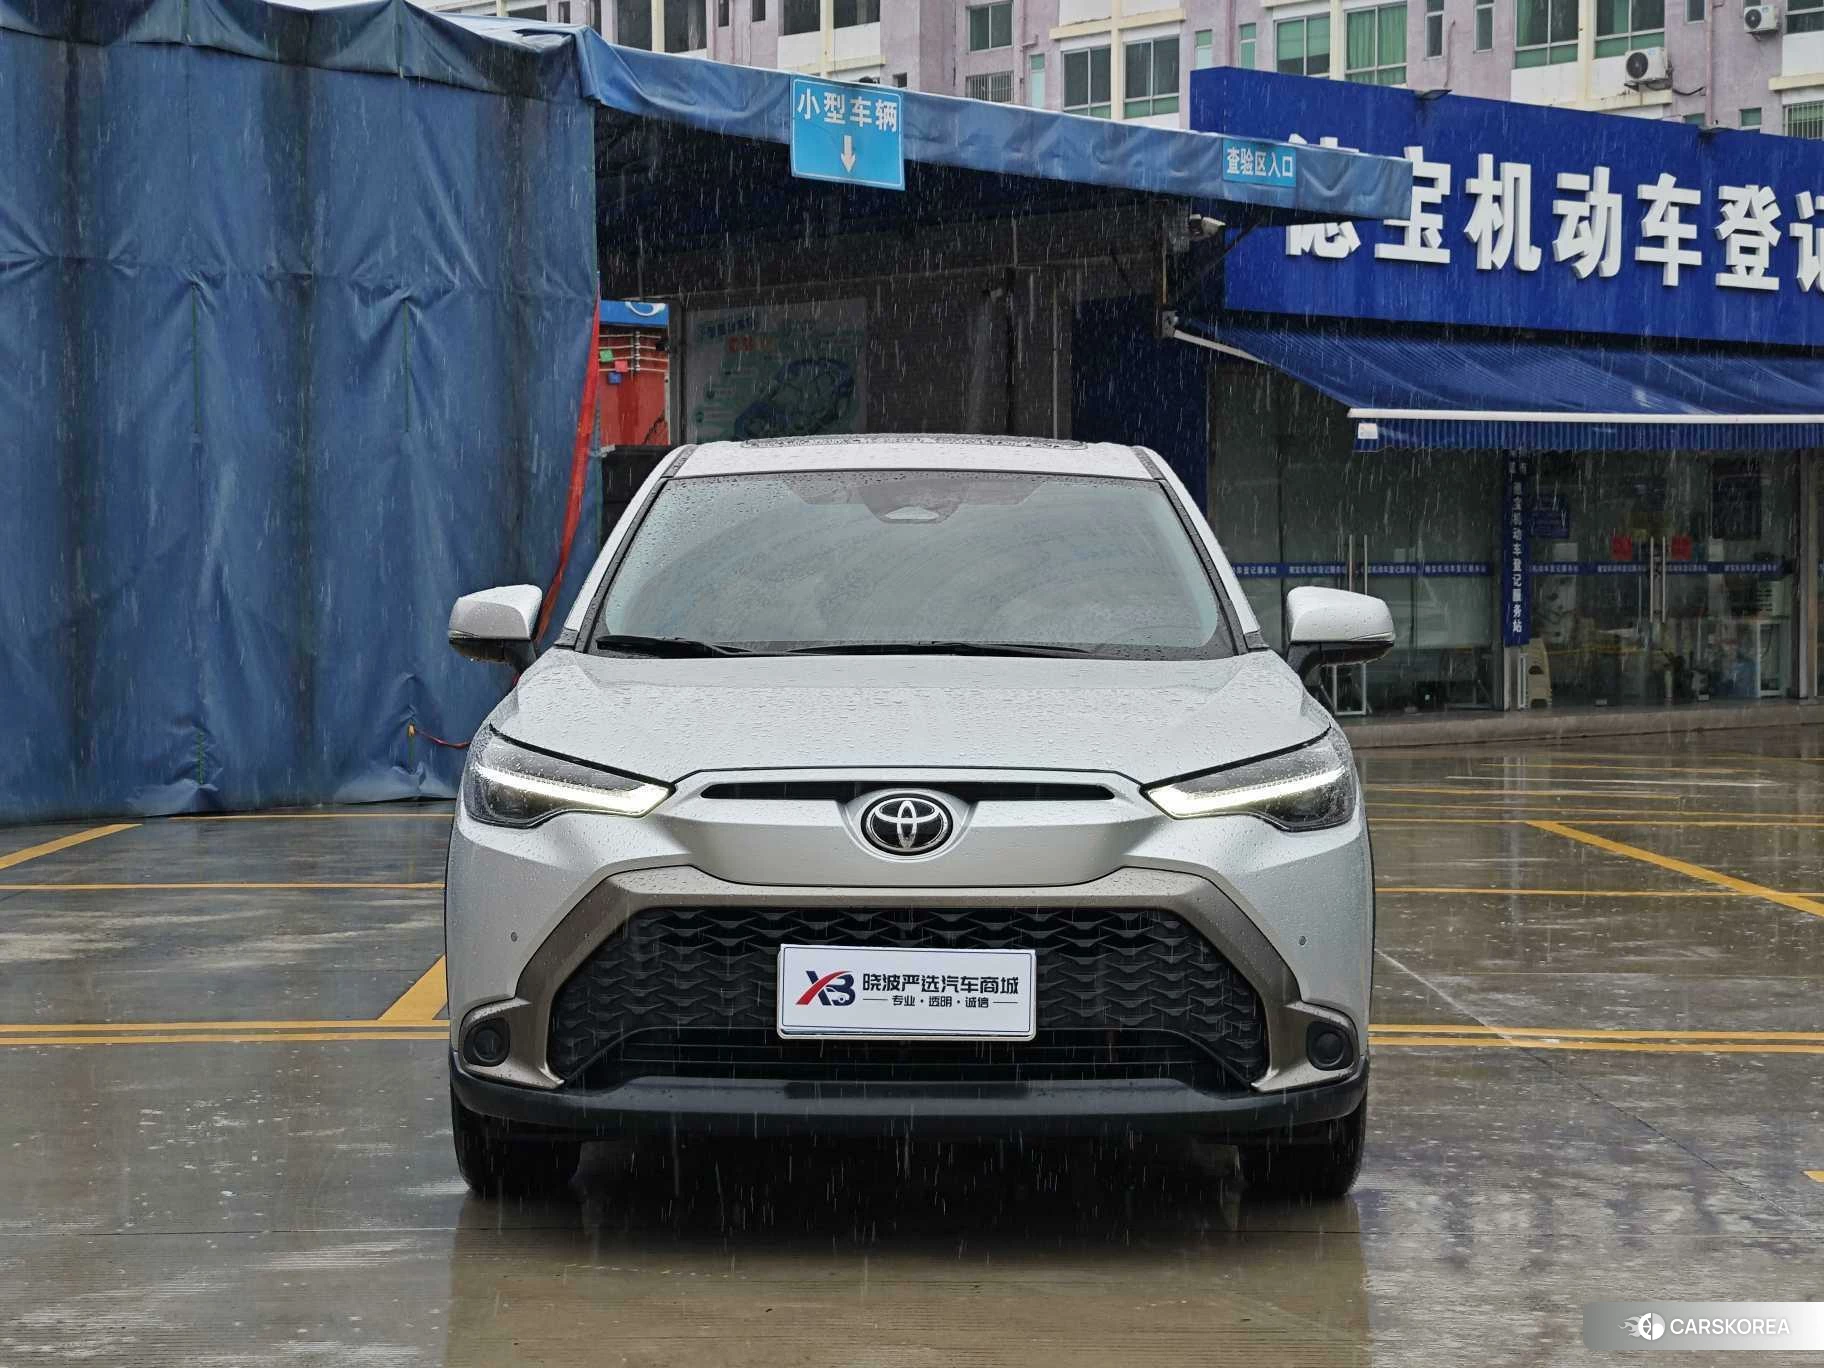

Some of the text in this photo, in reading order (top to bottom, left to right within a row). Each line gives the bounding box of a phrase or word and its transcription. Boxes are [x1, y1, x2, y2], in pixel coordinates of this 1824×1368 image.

[797, 88, 898, 132] 小型车辆
[1226, 146, 1293, 178] 查验区入口
[862, 973, 1019, 994] 晓波严选汽车商城
